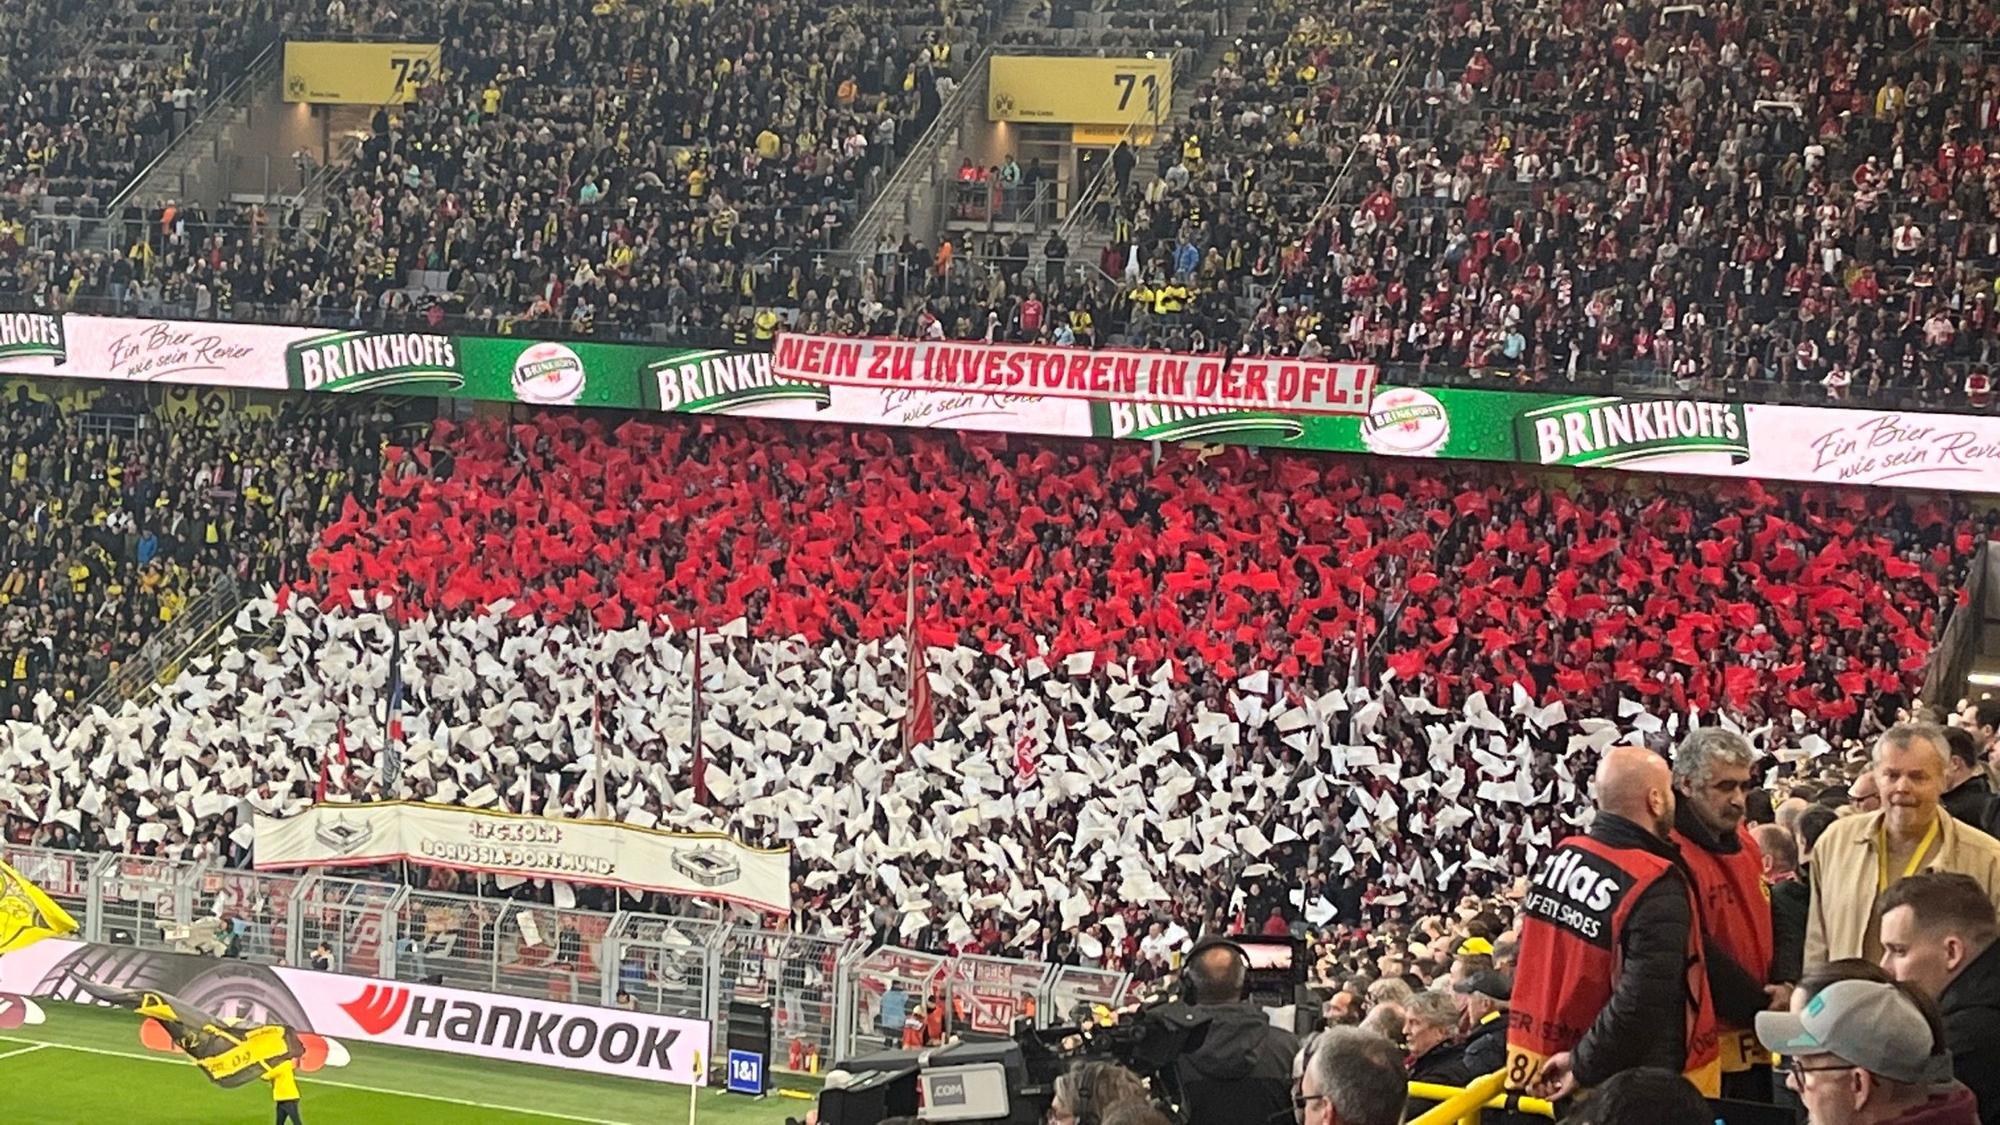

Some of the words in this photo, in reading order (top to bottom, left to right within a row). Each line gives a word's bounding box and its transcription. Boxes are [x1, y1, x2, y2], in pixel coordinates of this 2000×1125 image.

[1114, 74, 1157, 111] 71
[109, 334, 140, 372] Ein
[141, 322, 194, 351] Bier
[127, 357, 153, 378] wie
[156, 352, 187, 368] sein
[191, 336, 254, 365] Revier
[779, 337, 858, 377] NEIN
[868, 345, 916, 380] ZU
[923, 346, 1140, 392] INVESTOREN
[1149, 359, 1189, 395] IN
[1197, 363, 1267, 400] DER
[1811, 428, 1856, 472] Ein
[1858, 414, 1936, 447] Bier
[1839, 457, 1876, 480] wie
[1881, 446, 1927, 468] sein
[1932, 431, 2000, 464] Revi
[732, 1059, 758, 1082] 1&1
